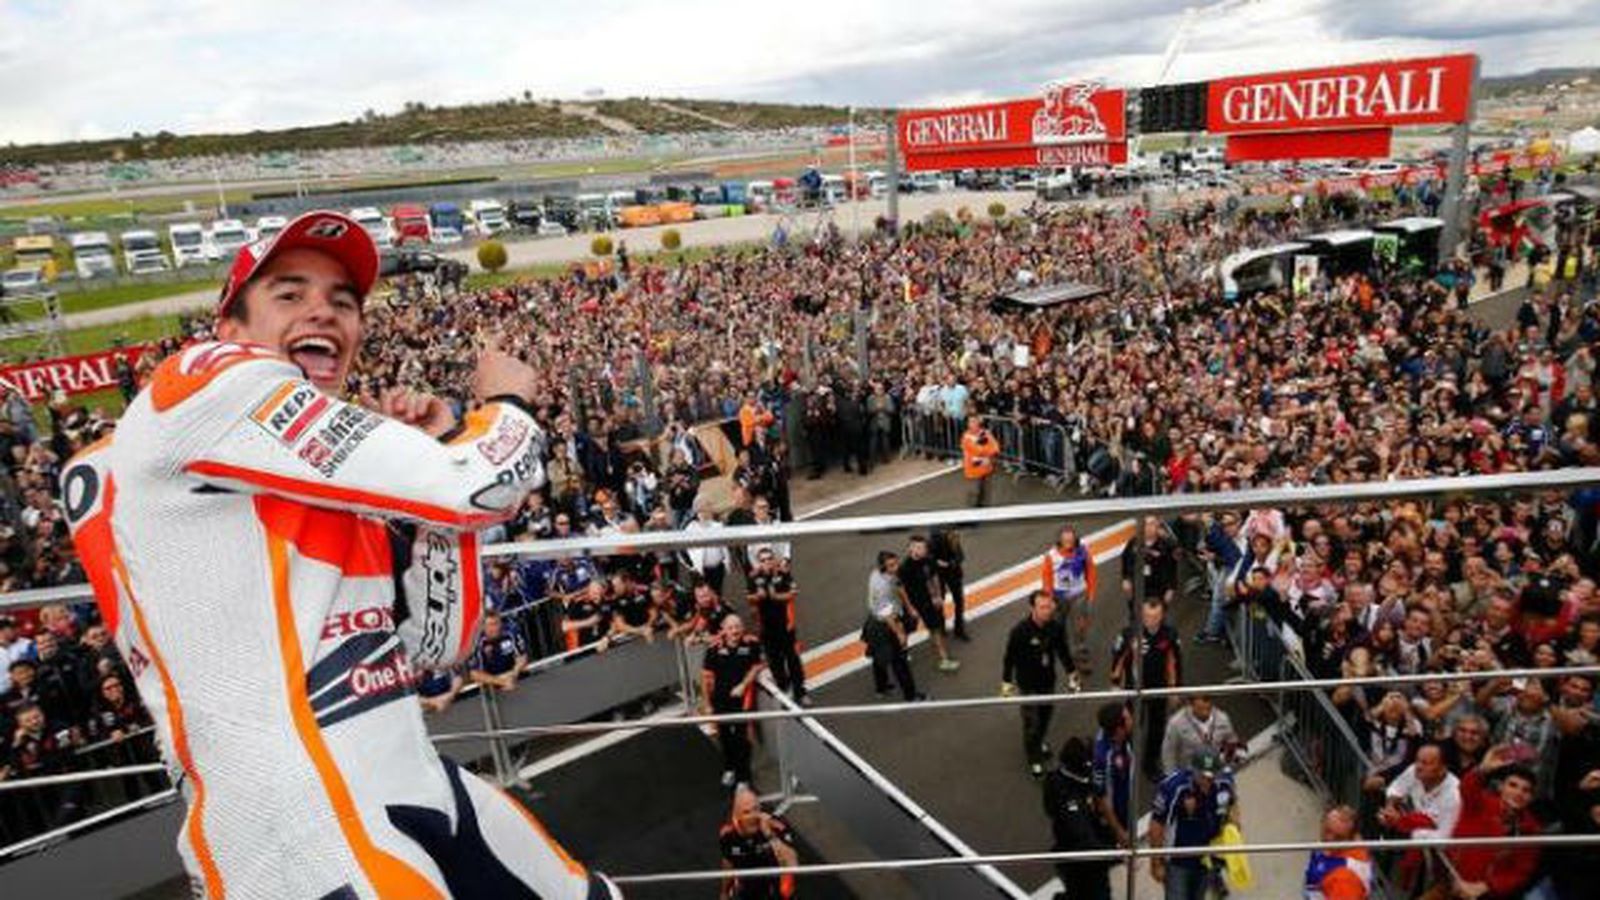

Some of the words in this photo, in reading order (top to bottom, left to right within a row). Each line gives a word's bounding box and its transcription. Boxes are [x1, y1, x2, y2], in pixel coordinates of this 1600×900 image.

[1222, 66, 1446, 125] GENERALI
[907, 109, 1008, 145] GENERALI
[1036, 144, 1109, 165] GENERALI
[351, 665, 395, 695] One
